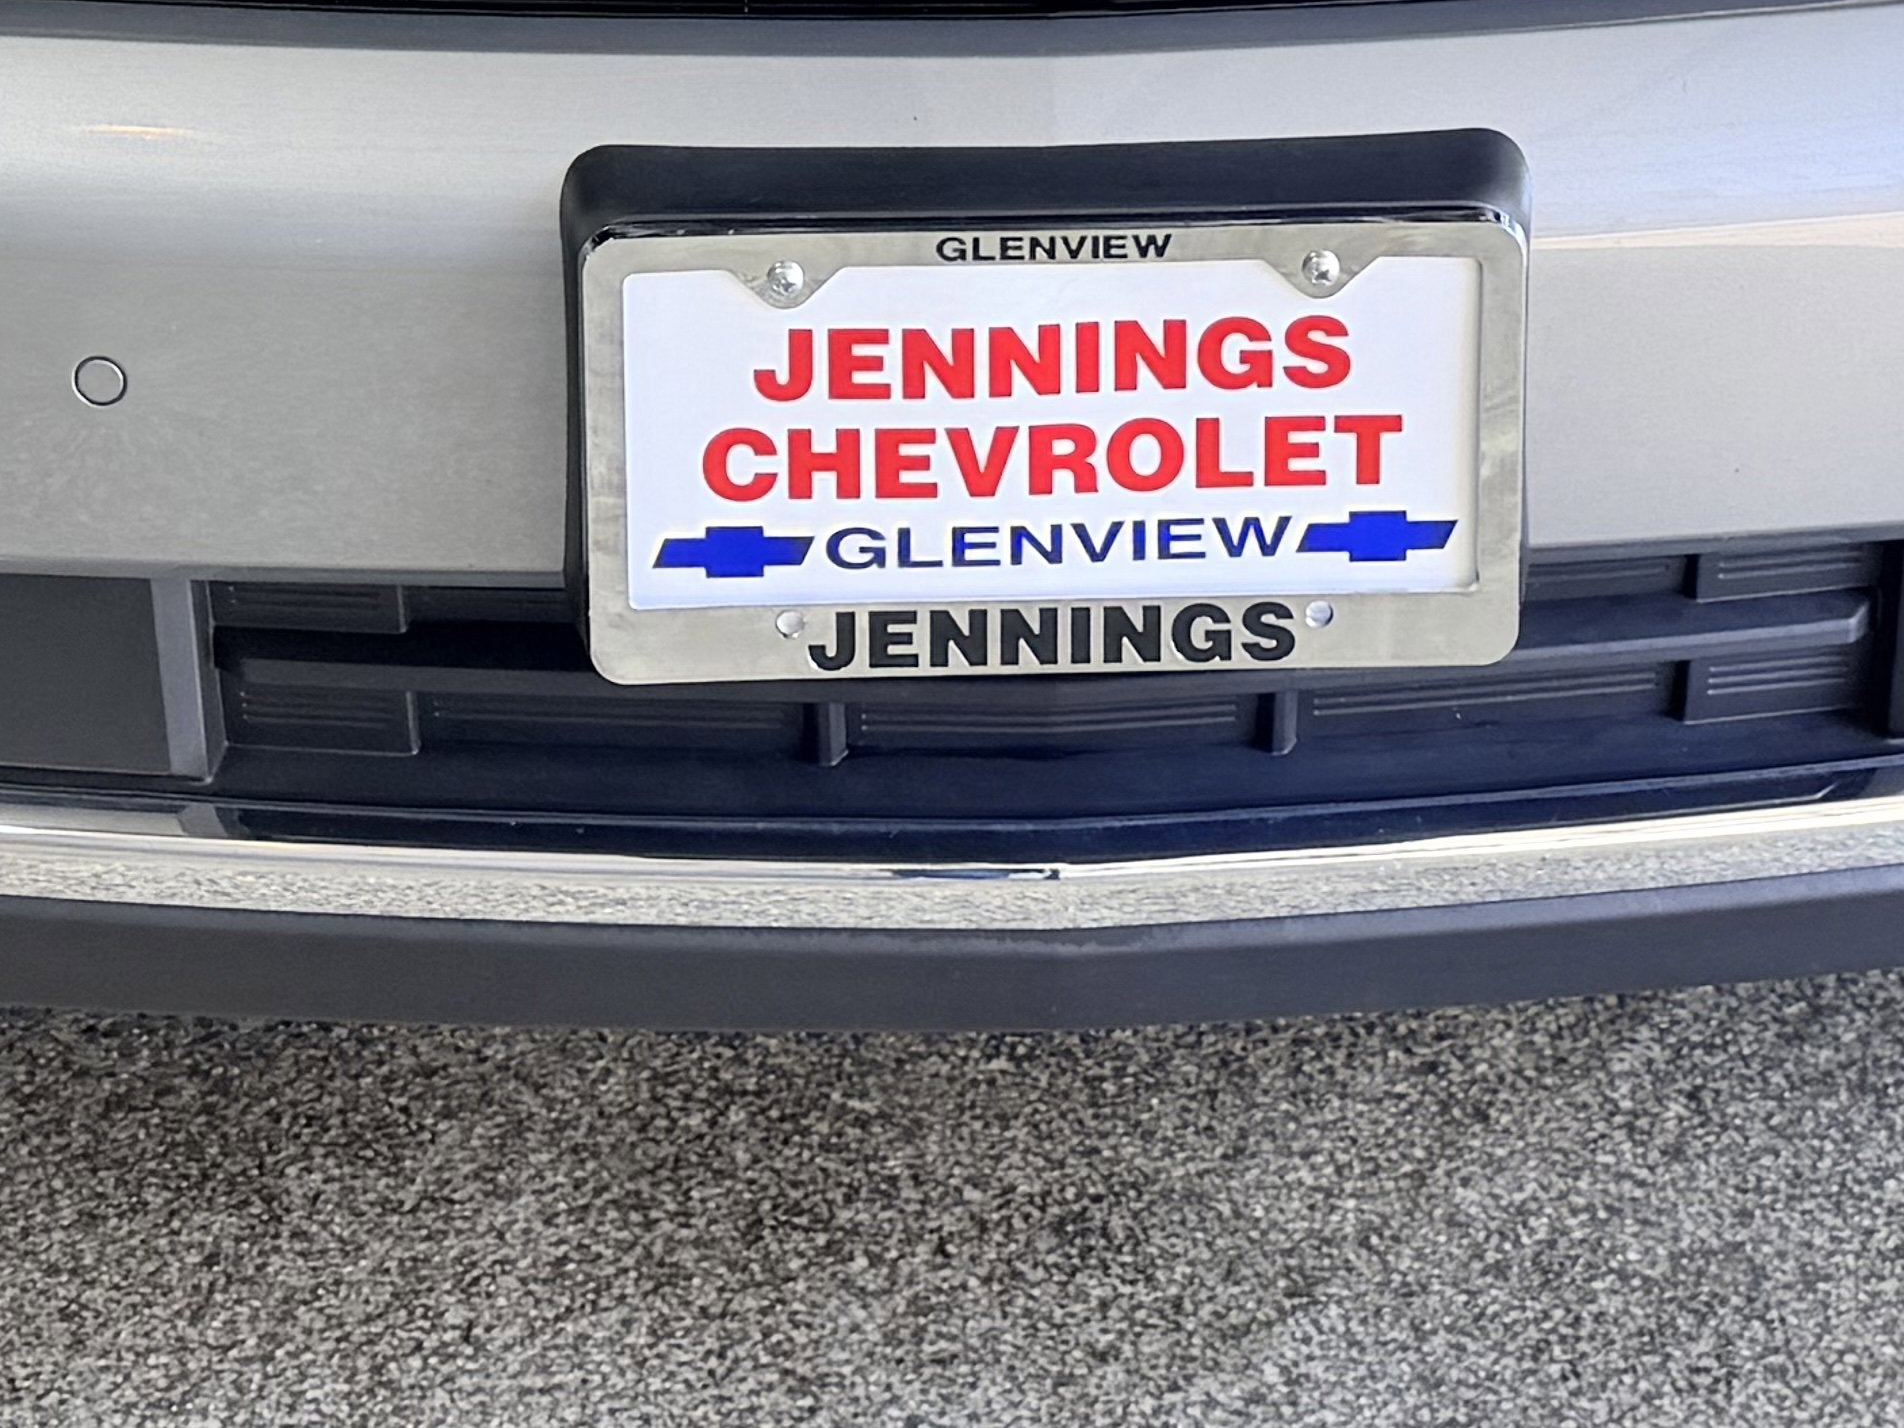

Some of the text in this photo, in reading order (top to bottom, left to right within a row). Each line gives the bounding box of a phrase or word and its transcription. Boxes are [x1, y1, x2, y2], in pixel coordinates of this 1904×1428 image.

[934, 232, 1174, 263] GLENVIEW
[753, 315, 1353, 403] JENNINGS
[702, 414, 1404, 504] CHEVROLET
[824, 514, 1294, 571] GLENVIEW
[806, 600, 1297, 673] JENNINGS
